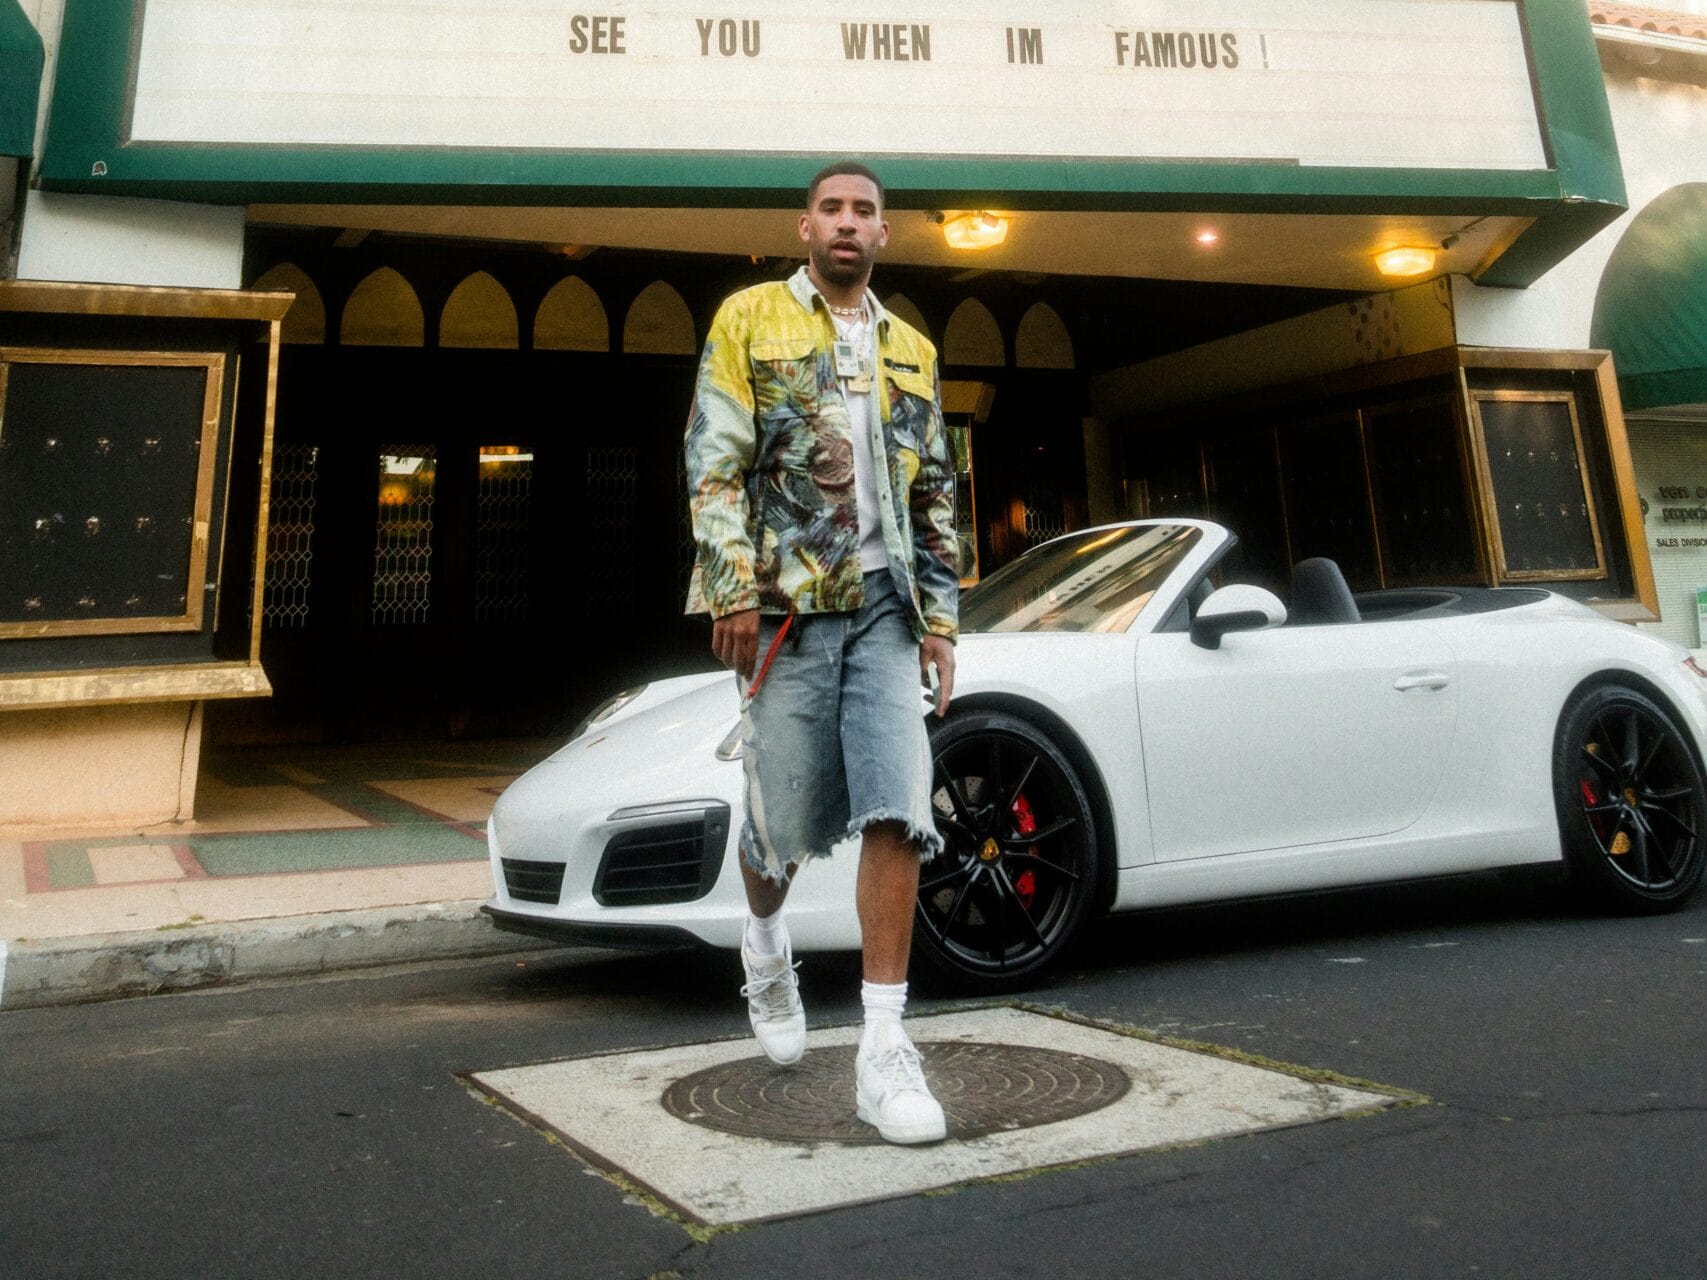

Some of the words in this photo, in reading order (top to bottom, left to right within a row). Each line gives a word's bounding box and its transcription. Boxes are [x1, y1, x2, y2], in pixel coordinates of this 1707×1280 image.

[569, 14, 626, 54] SEE
[695, 18, 760, 57] YOU
[840, 22, 931, 61] WHEN
[1005, 27, 1044, 65] IM
[1114, 31, 1239, 69] FAMOUS
[1656, 538, 1679, 548] SALES
